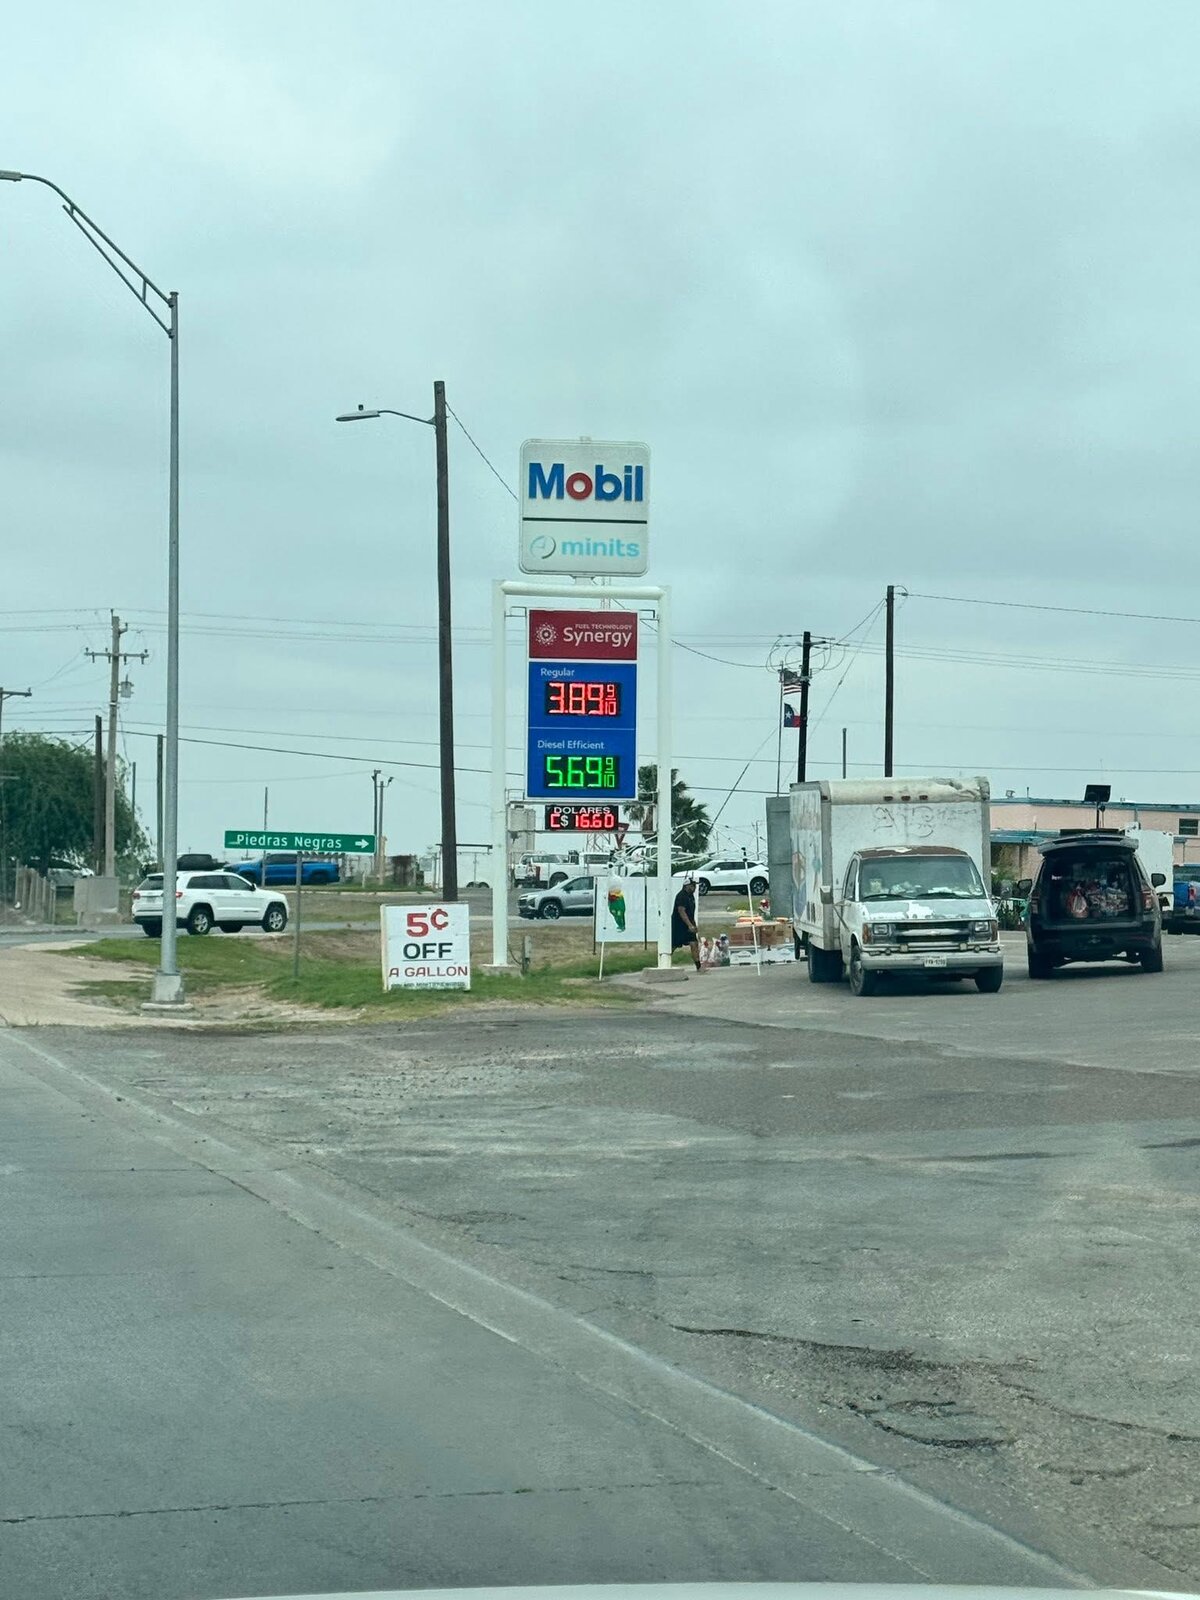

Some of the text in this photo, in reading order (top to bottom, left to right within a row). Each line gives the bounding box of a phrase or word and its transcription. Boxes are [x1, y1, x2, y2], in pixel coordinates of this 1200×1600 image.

[528, 462, 644, 502] Mobil
[561, 537, 640, 557] minits
[563, 627, 632, 647] Synergy
[540, 667, 575, 678] Regular
[537, 739, 605, 749] Diesel Efficient
[553, 806, 611, 815] DOLARES
[236, 833, 342, 851] Piedras Negras
[403, 942, 453, 959] OFF
[388, 966, 468, 977] A GALLON
